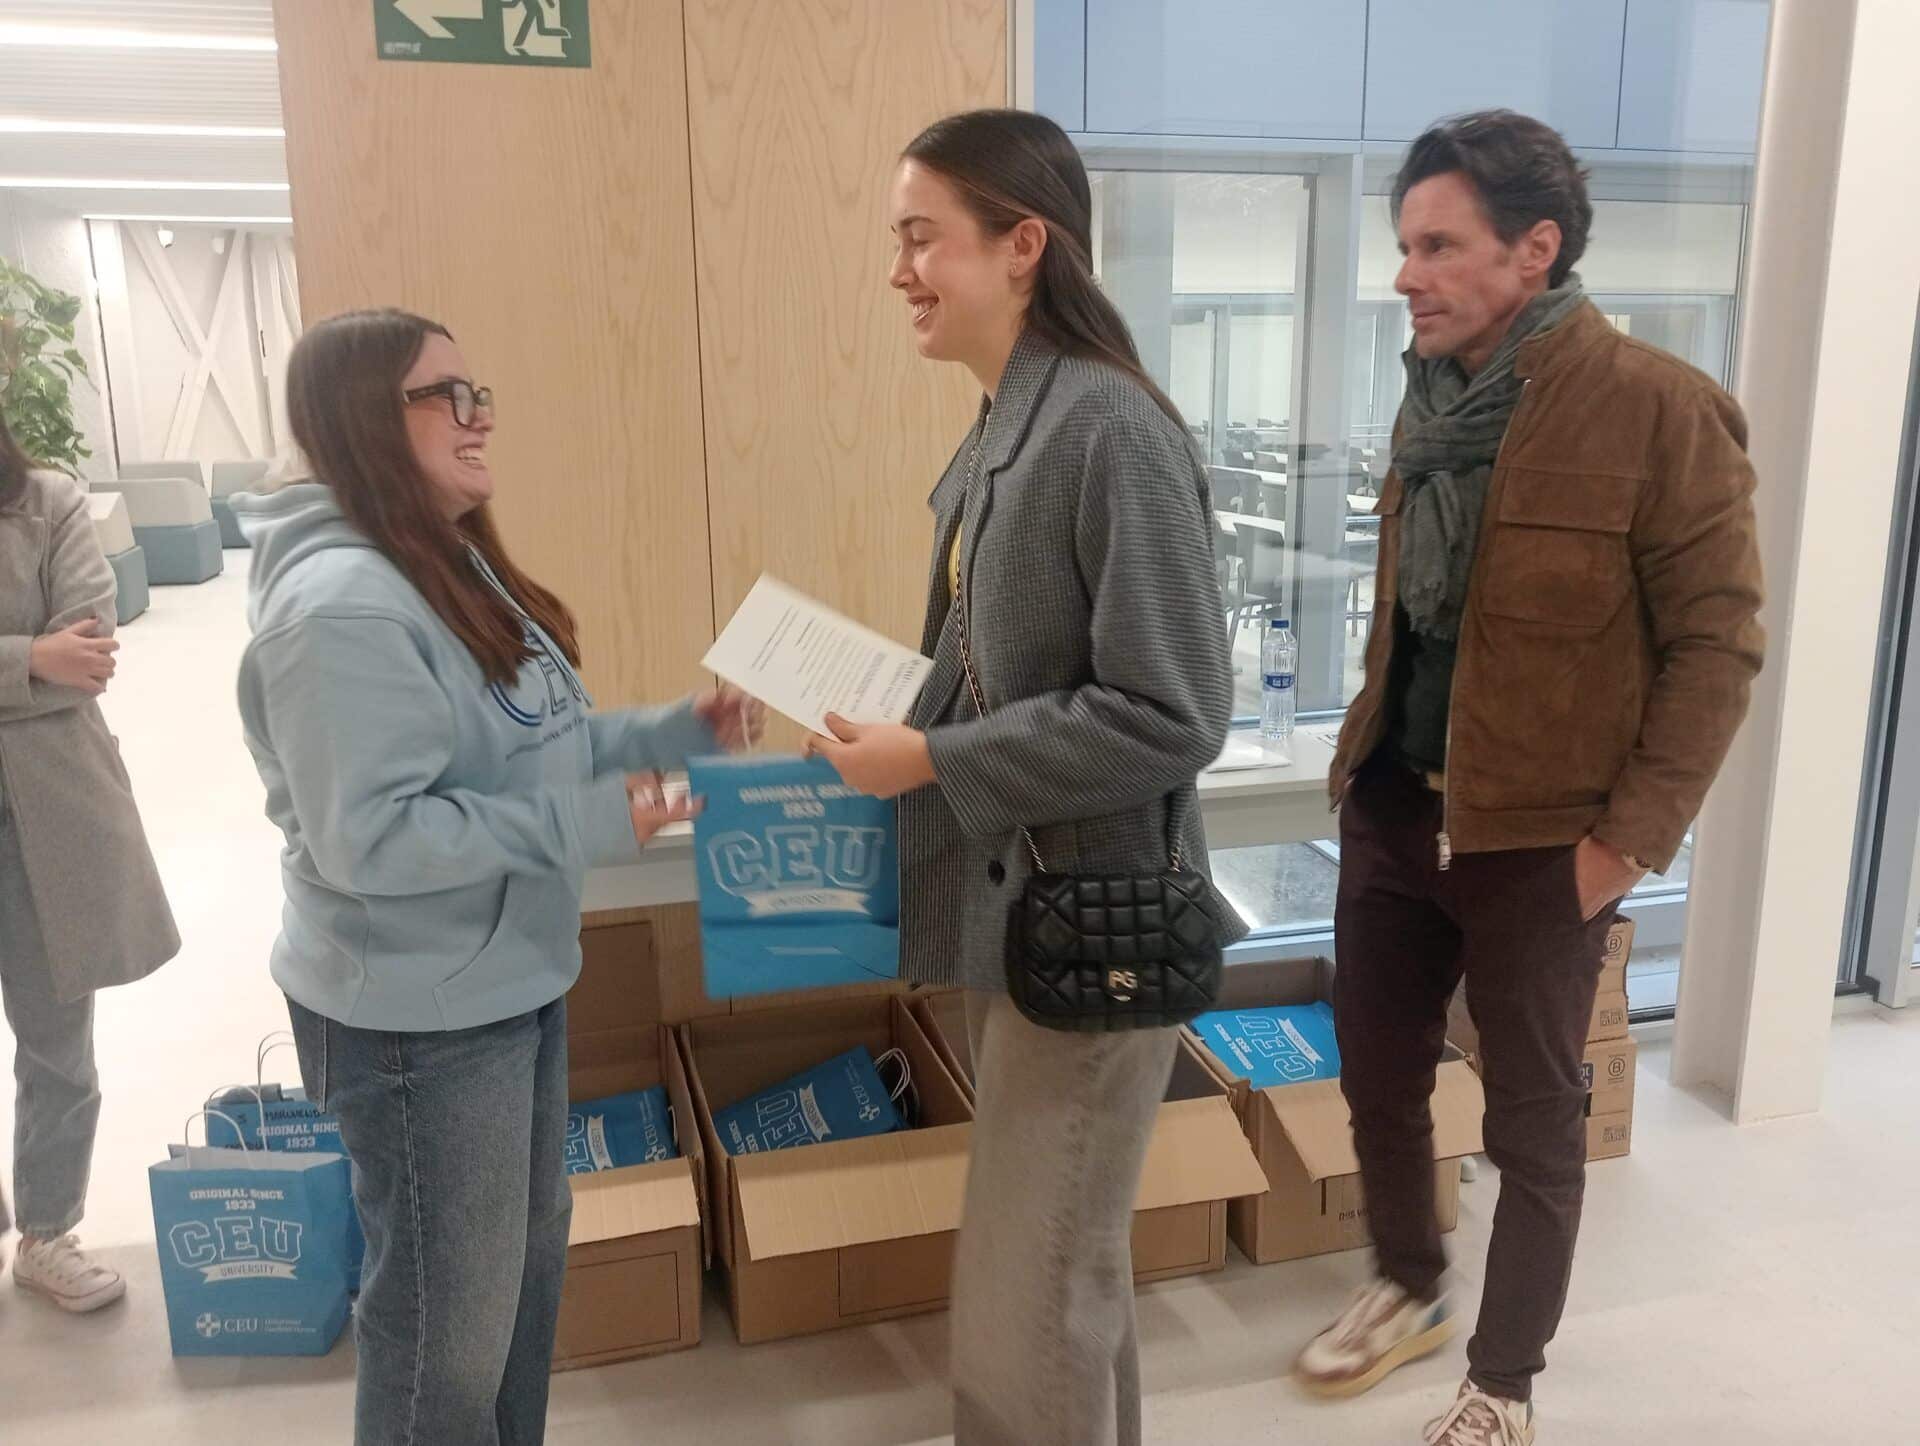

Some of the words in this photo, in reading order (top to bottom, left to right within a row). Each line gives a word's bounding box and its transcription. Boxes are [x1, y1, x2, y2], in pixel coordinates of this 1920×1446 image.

[706, 825, 886, 897] CEU
[1235, 1015, 1316, 1081] CEU
[189, 1188, 248, 1200] ORIGINAL
[249, 1188, 285, 1200] SINCE
[225, 1200, 256, 1211] 1933
[169, 1216, 302, 1268] CEU
[220, 1263, 275, 1278] UNIVERSITY
[224, 1318, 258, 1333] CEU
